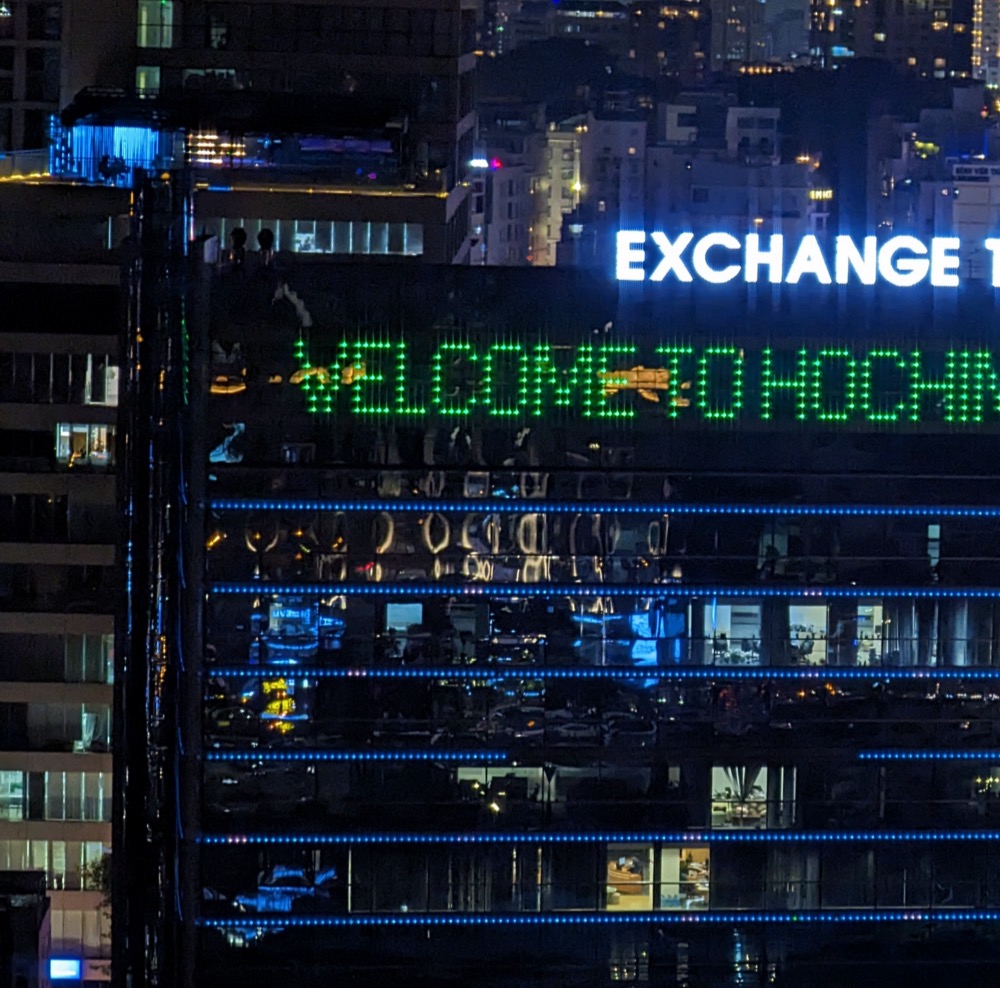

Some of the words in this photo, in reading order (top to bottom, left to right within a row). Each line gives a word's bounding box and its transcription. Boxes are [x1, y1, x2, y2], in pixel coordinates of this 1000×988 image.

[615, 231, 960, 287] EXCHANGE
[294, 339, 638, 419] WELCOME
[654, 344, 744, 421] TO
